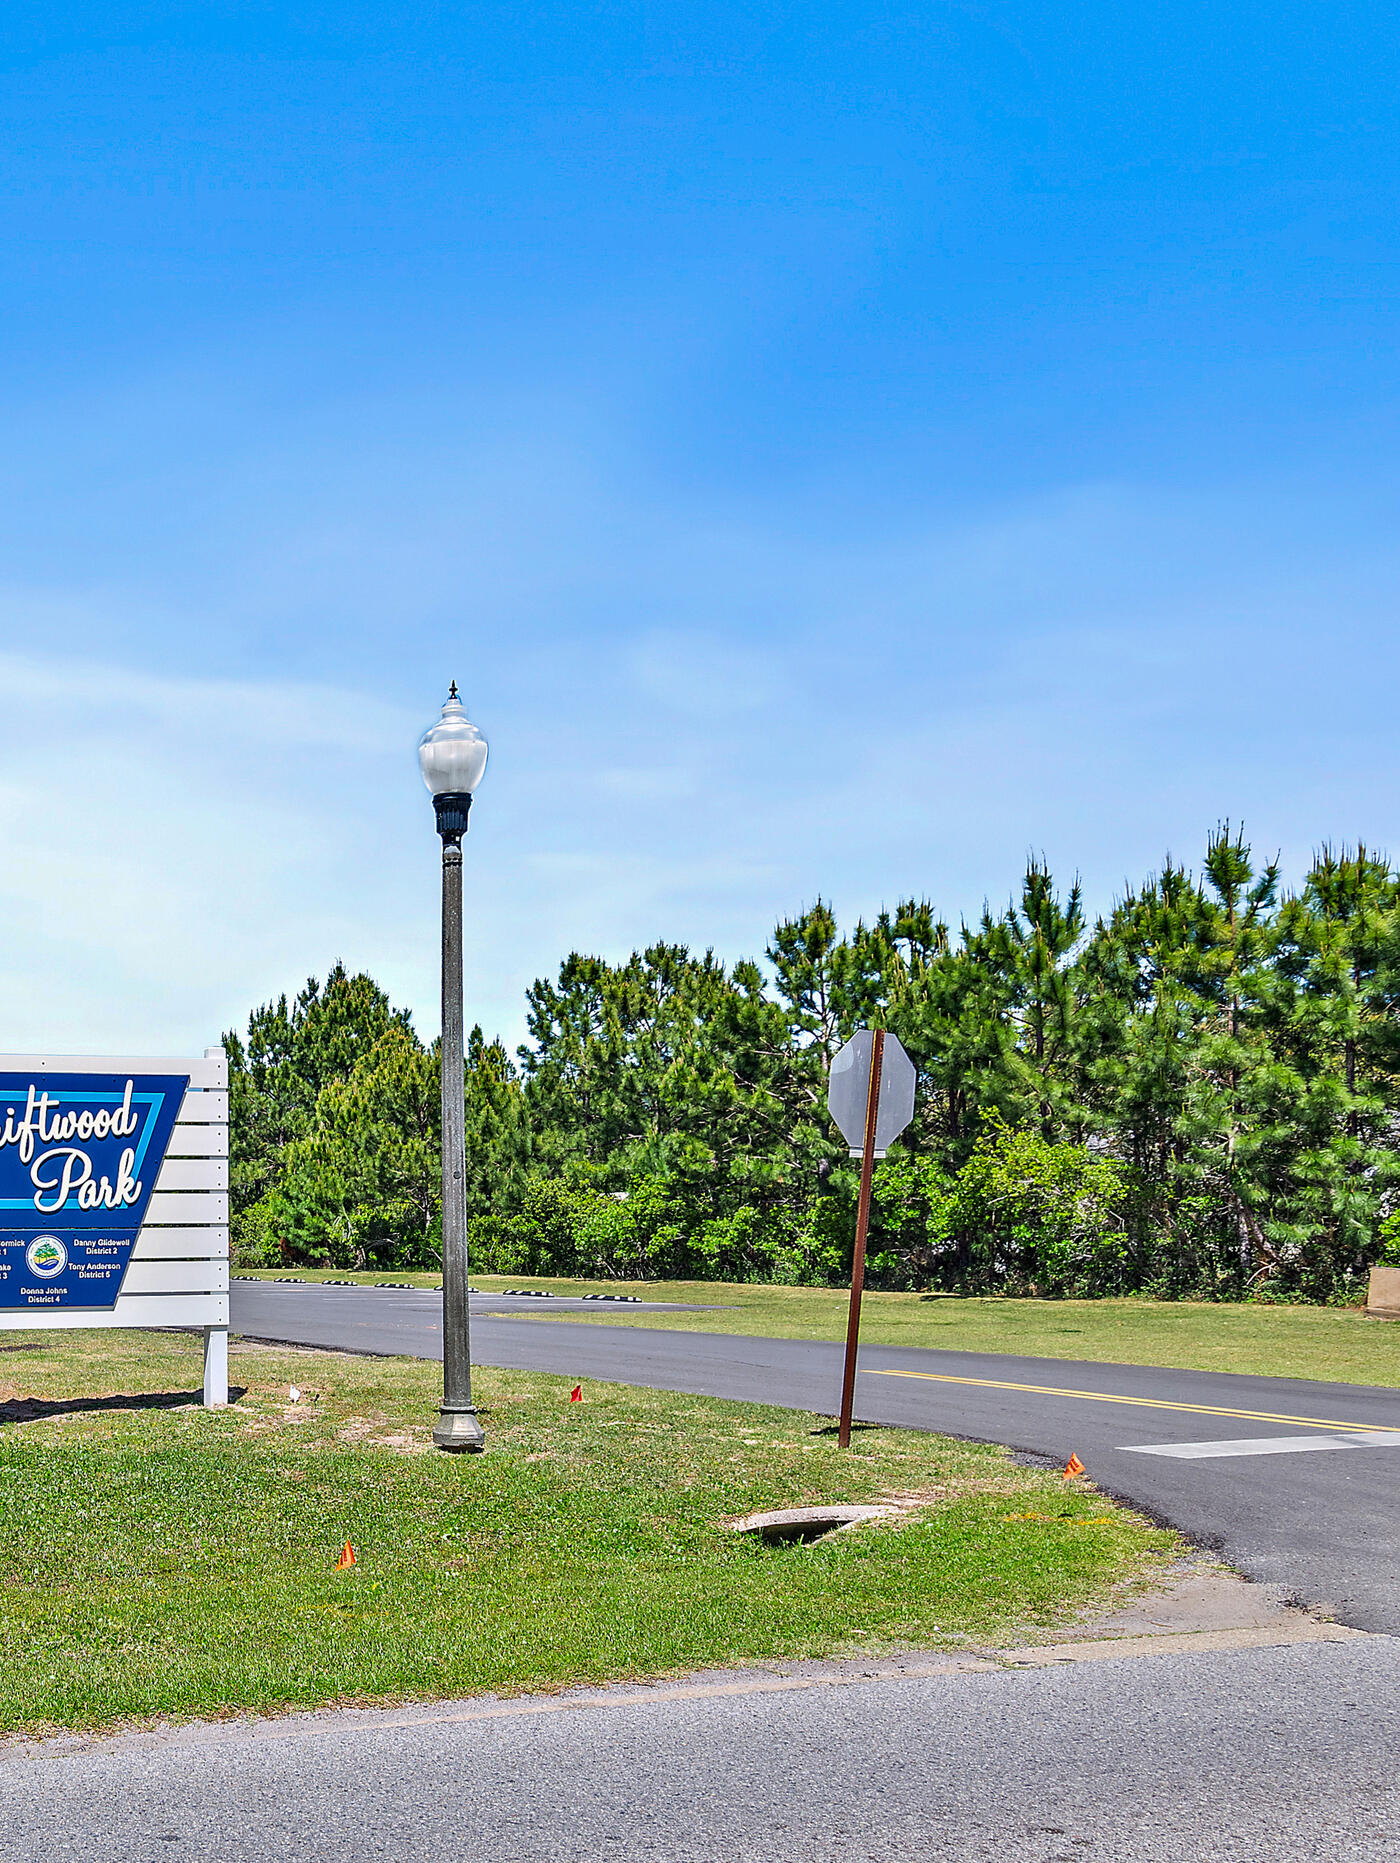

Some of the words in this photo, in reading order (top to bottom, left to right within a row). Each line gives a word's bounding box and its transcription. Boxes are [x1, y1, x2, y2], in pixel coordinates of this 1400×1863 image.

[30, 1147, 142, 1212] Park
[73, 1239, 96, 1248] Danny
[85, 1247, 111, 1255] District
[68, 1262, 86, 1271] Tony
[87, 1262, 121, 1270] Anderson
[78, 1271, 104, 1279] District
[20, 1287, 44, 1295] Donna
[45, 1287, 68, 1295] Johns
